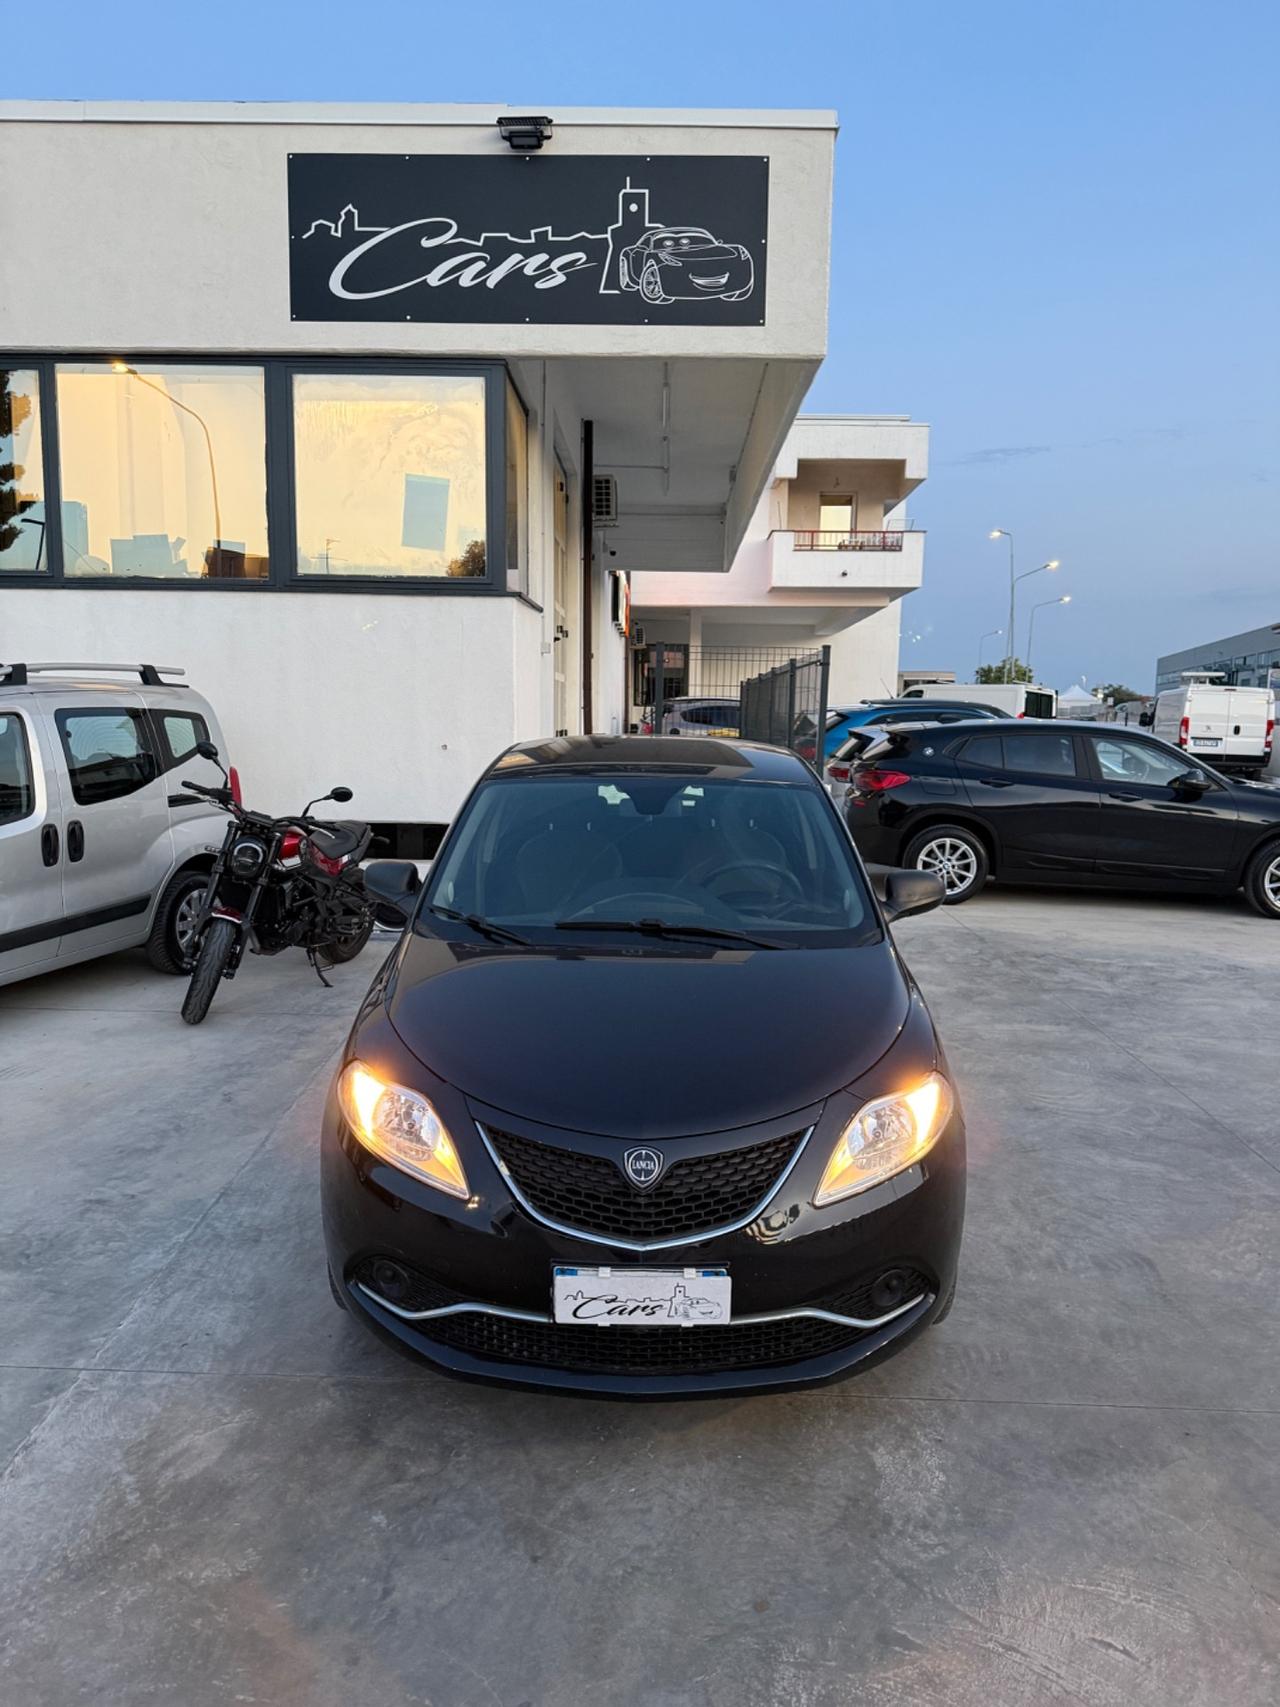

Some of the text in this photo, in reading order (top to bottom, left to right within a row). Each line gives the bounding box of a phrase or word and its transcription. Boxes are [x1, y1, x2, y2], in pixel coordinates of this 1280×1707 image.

[329, 217, 597, 300] Cars
[632, 1160, 655, 1170] LANCIA
[572, 1294, 664, 1319] Cars
